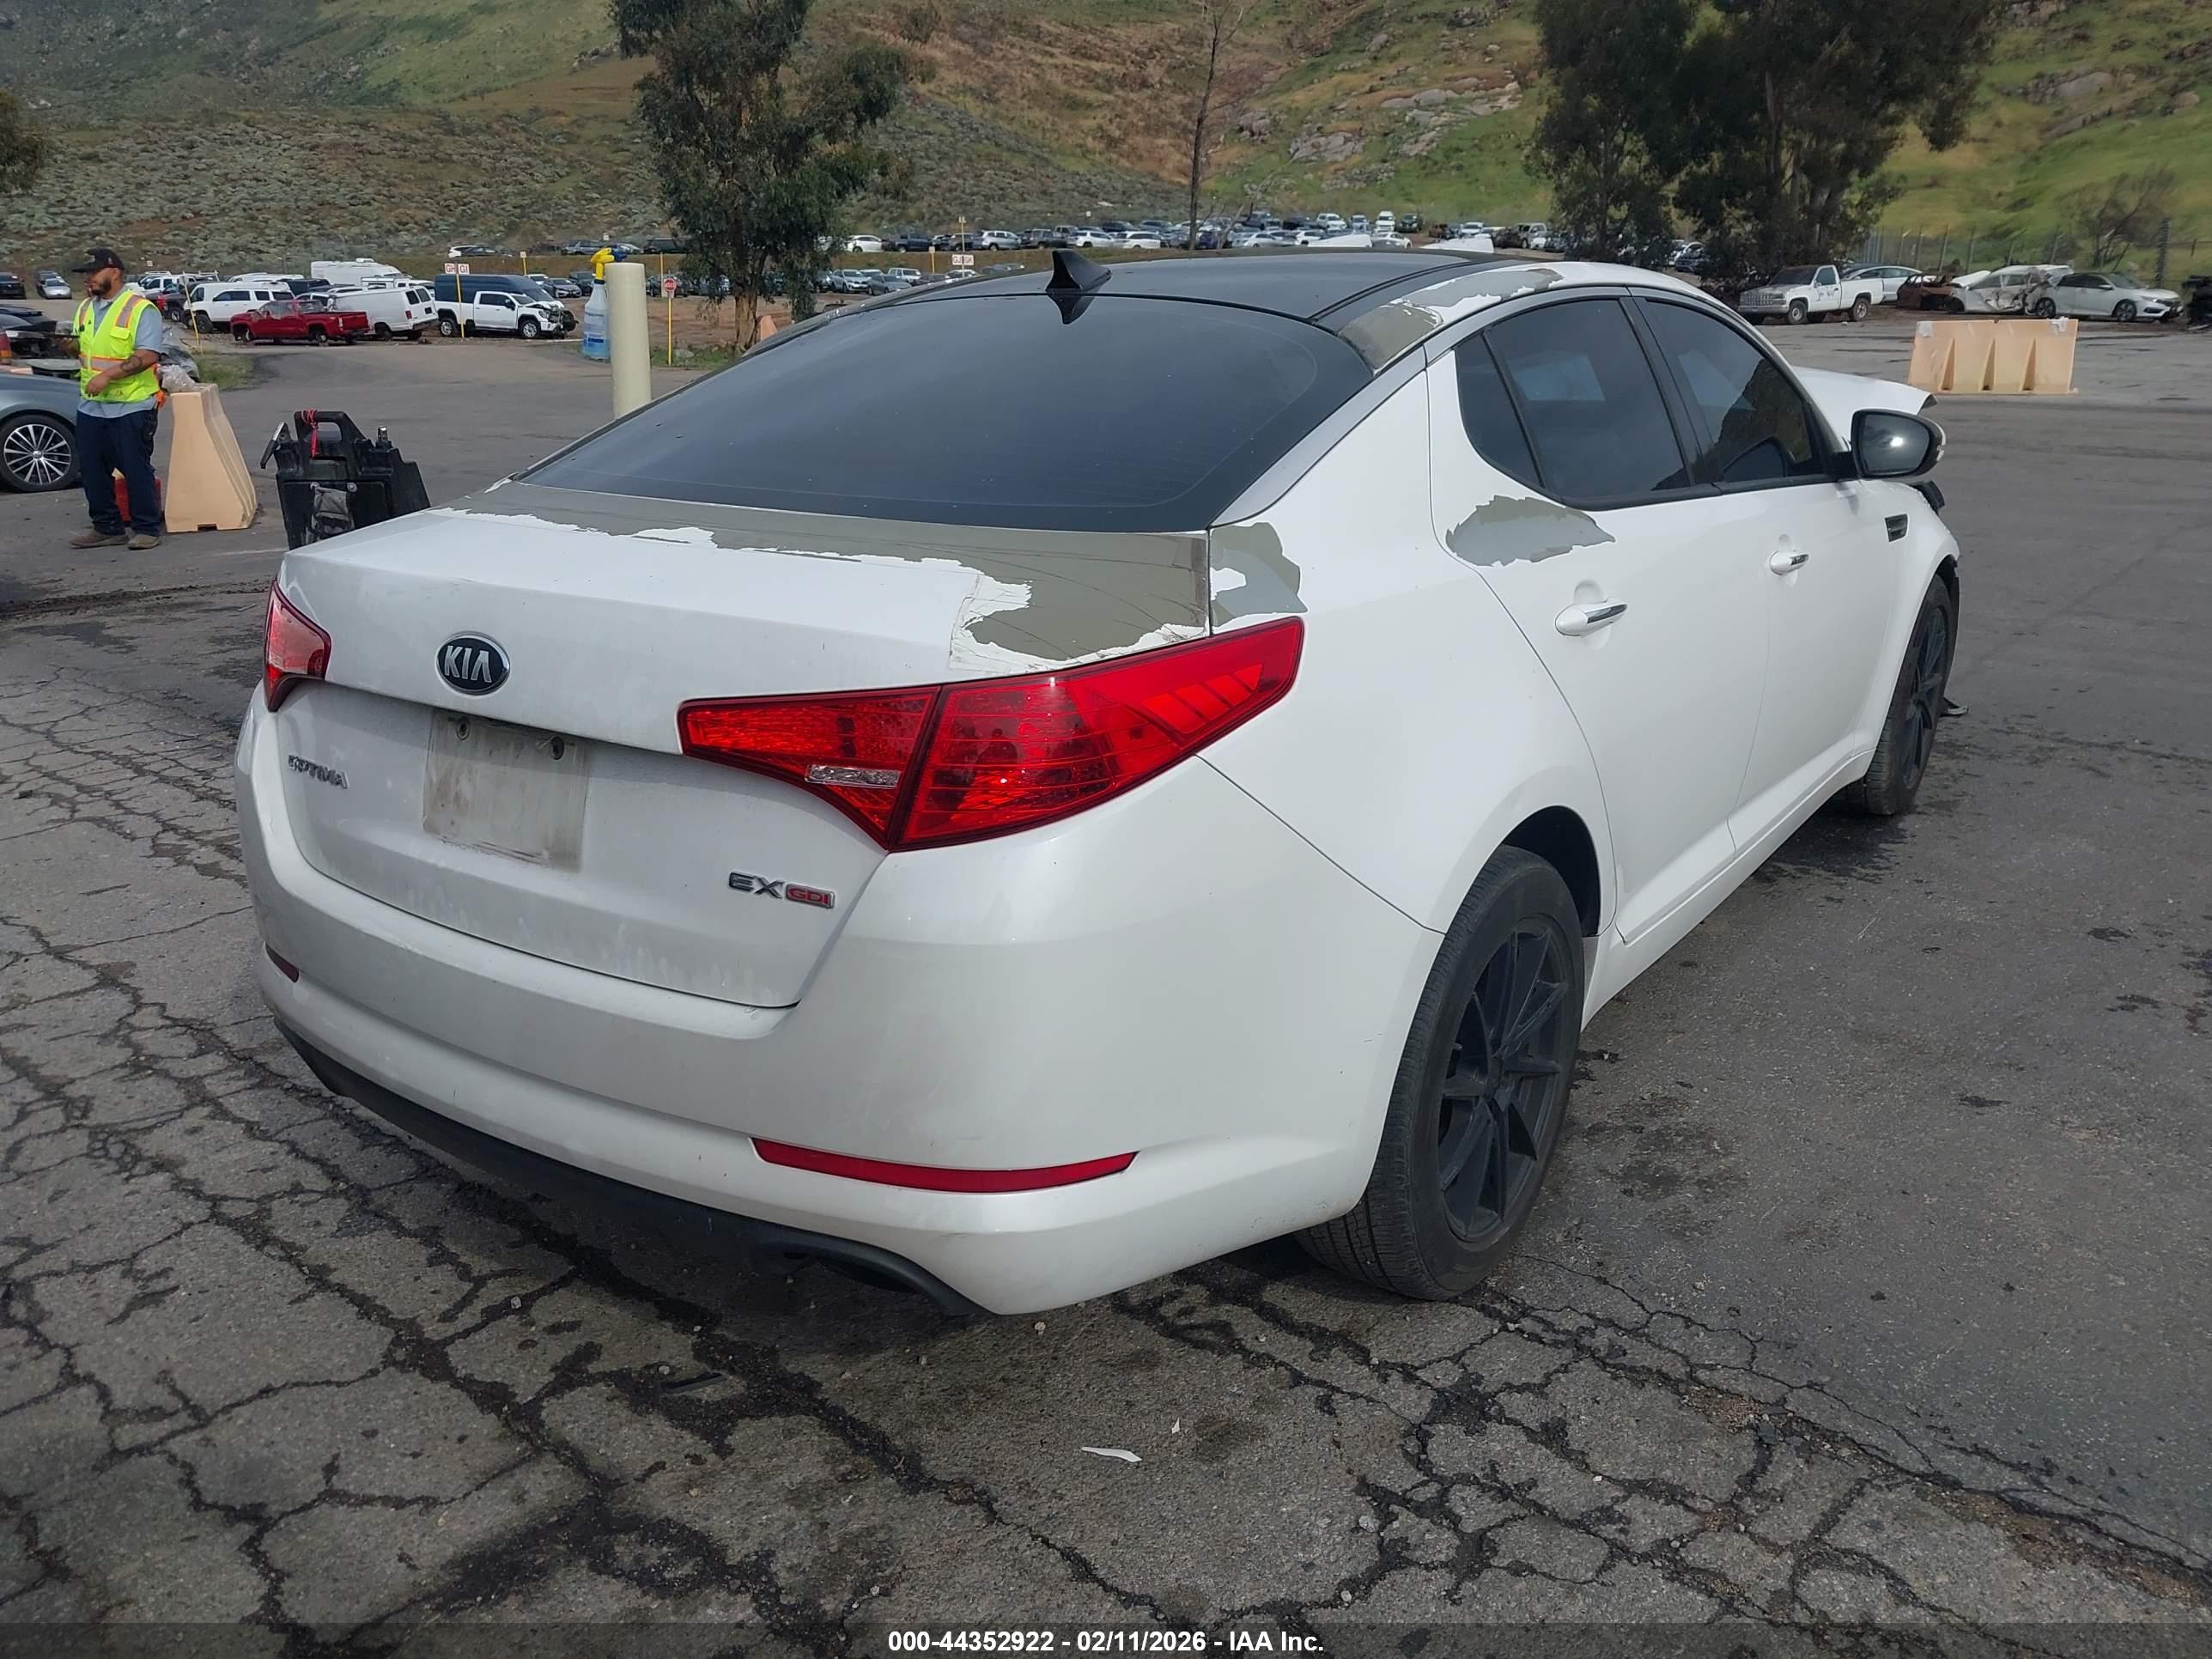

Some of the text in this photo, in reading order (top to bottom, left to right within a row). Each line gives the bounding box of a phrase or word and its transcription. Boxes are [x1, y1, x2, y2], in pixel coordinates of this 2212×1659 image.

[444, 645, 492, 684] KIA
[288, 755, 348, 789] OPTIMA
[728, 872, 830, 905] EX GDI
